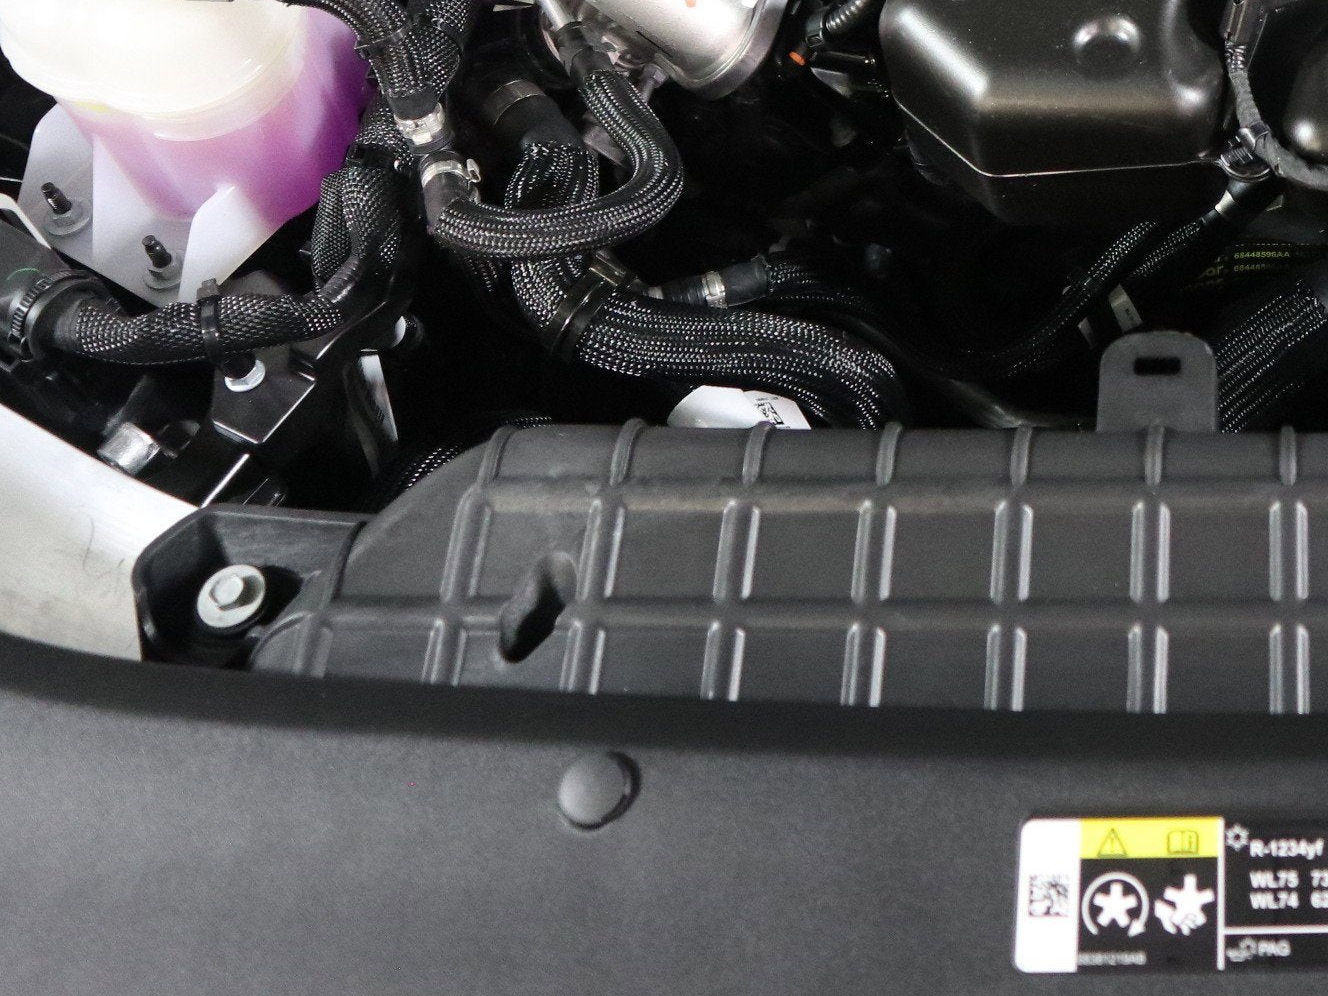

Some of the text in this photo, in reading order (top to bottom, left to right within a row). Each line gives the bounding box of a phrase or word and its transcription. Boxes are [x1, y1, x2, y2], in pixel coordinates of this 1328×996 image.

[1250, 838, 1325, 860] R-1234yf
[1249, 869, 1299, 889] WL75
[1249, 890, 1299, 910] WL74
